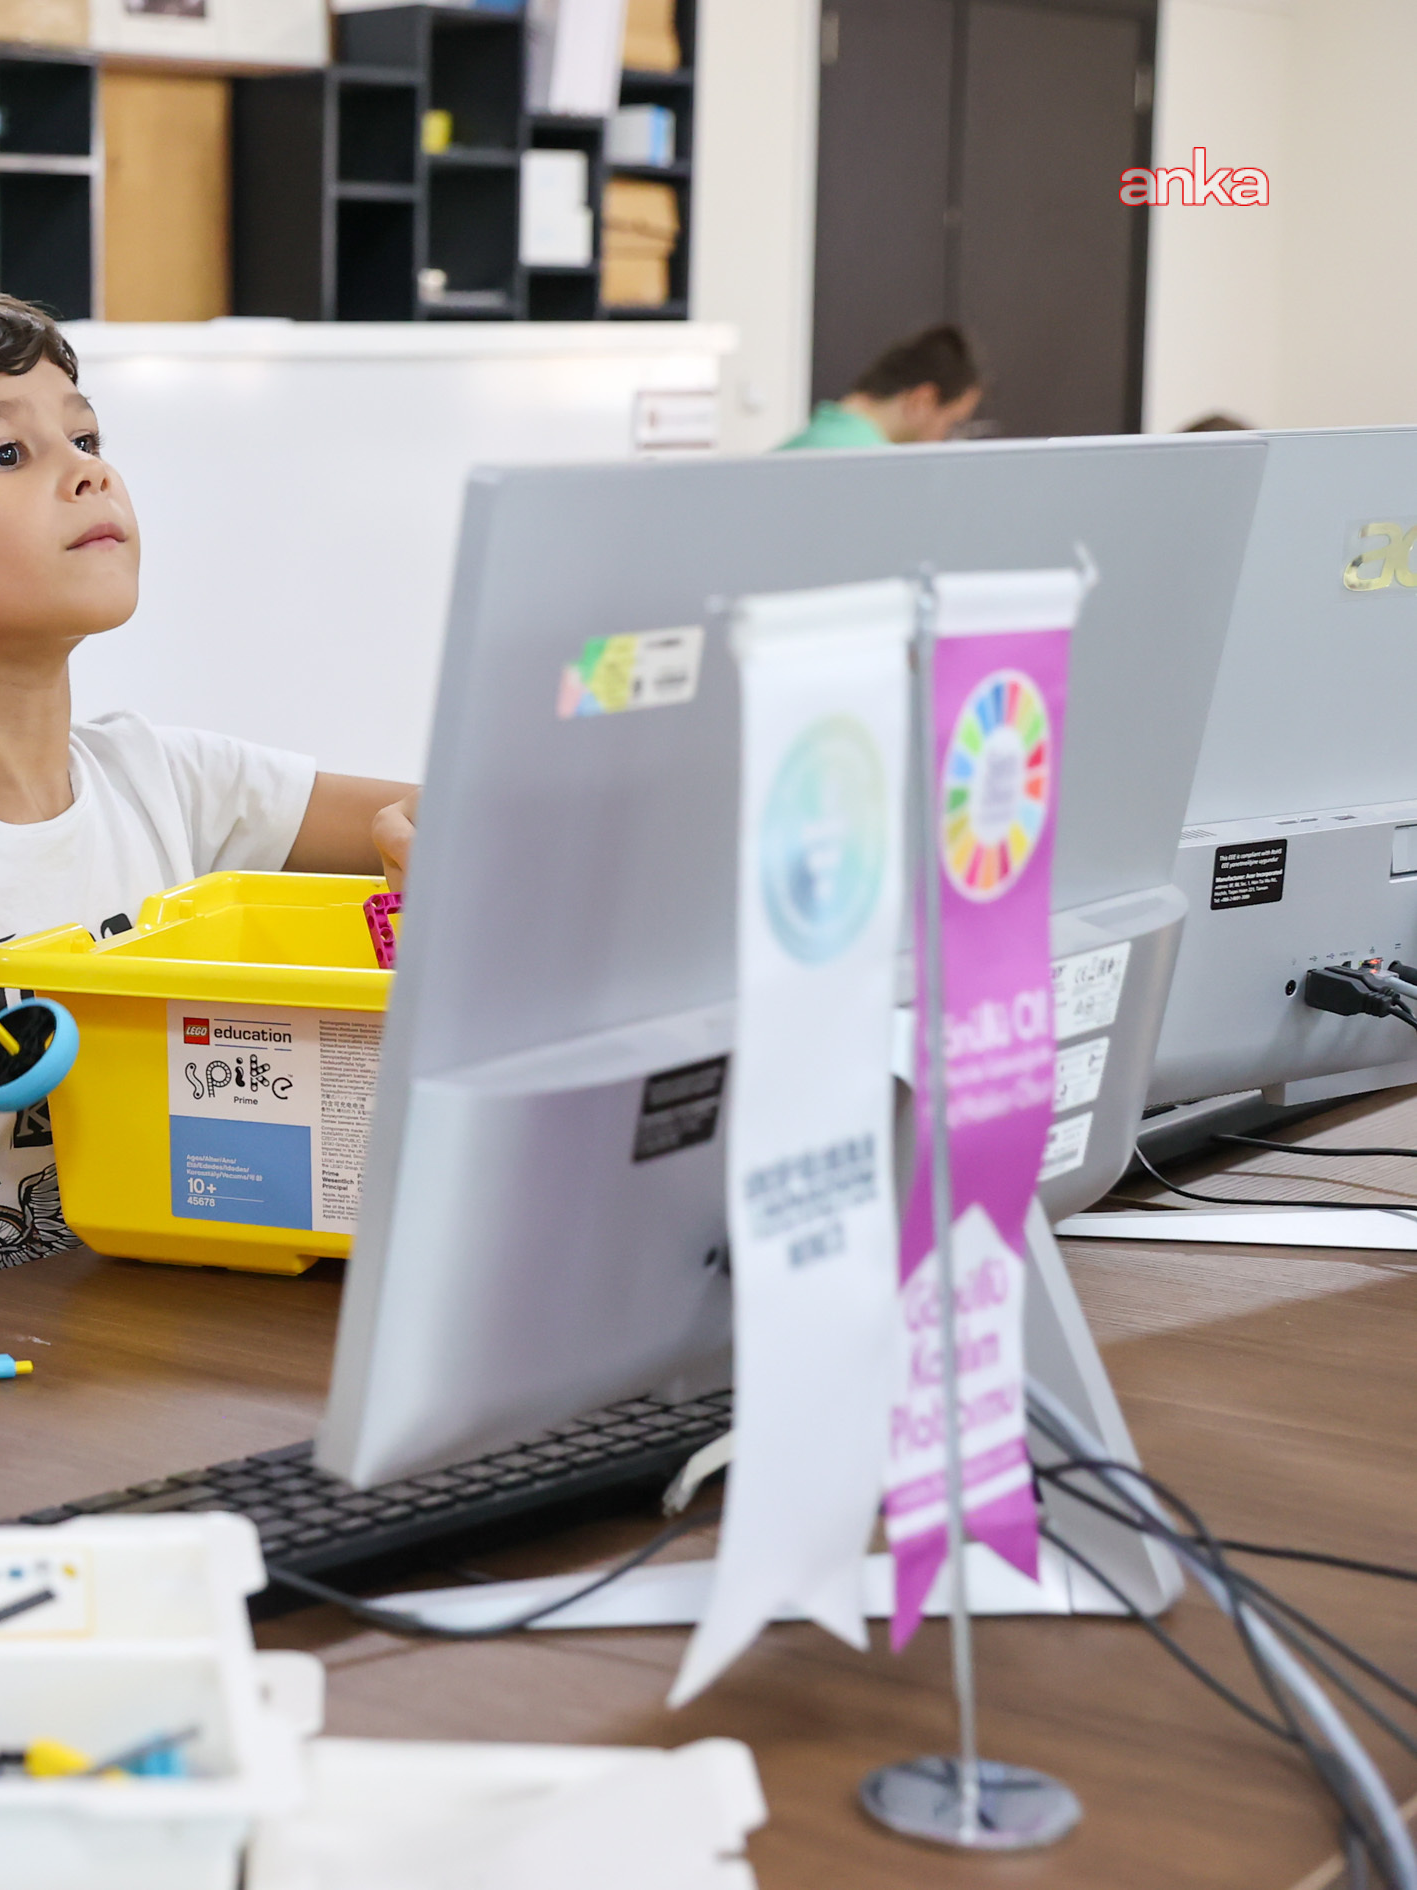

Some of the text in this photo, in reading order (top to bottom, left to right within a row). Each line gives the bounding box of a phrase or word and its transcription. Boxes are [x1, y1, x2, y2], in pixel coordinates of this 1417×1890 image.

[186, 1025, 292, 1043] LEGO education
[234, 1096, 258, 1105] Prime
[187, 1196, 215, 1207] 45678
